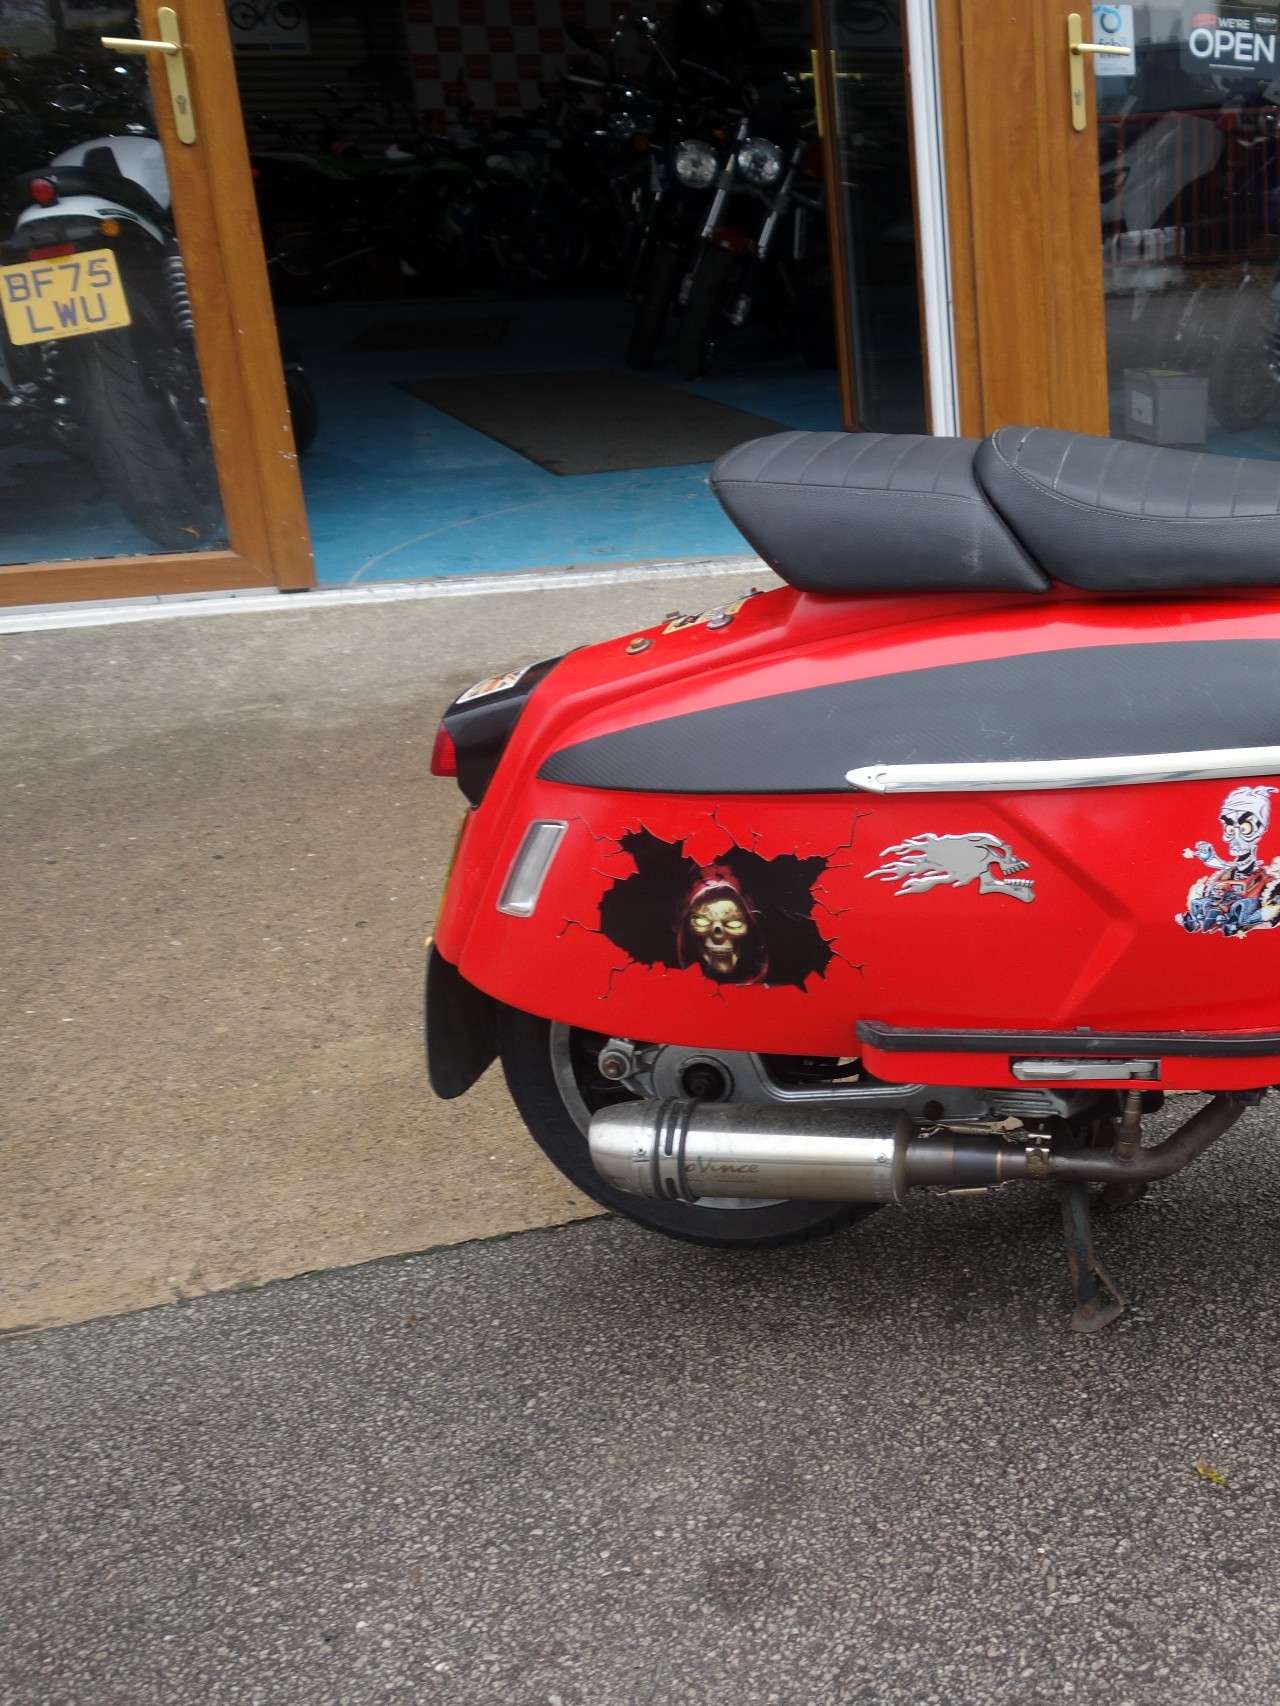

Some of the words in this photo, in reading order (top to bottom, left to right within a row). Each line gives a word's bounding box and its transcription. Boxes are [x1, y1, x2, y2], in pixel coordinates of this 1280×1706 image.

[1189, 28, 1276, 63] OPEN
[4, 258, 112, 303] BF75
[26, 293, 107, 333] LWU
